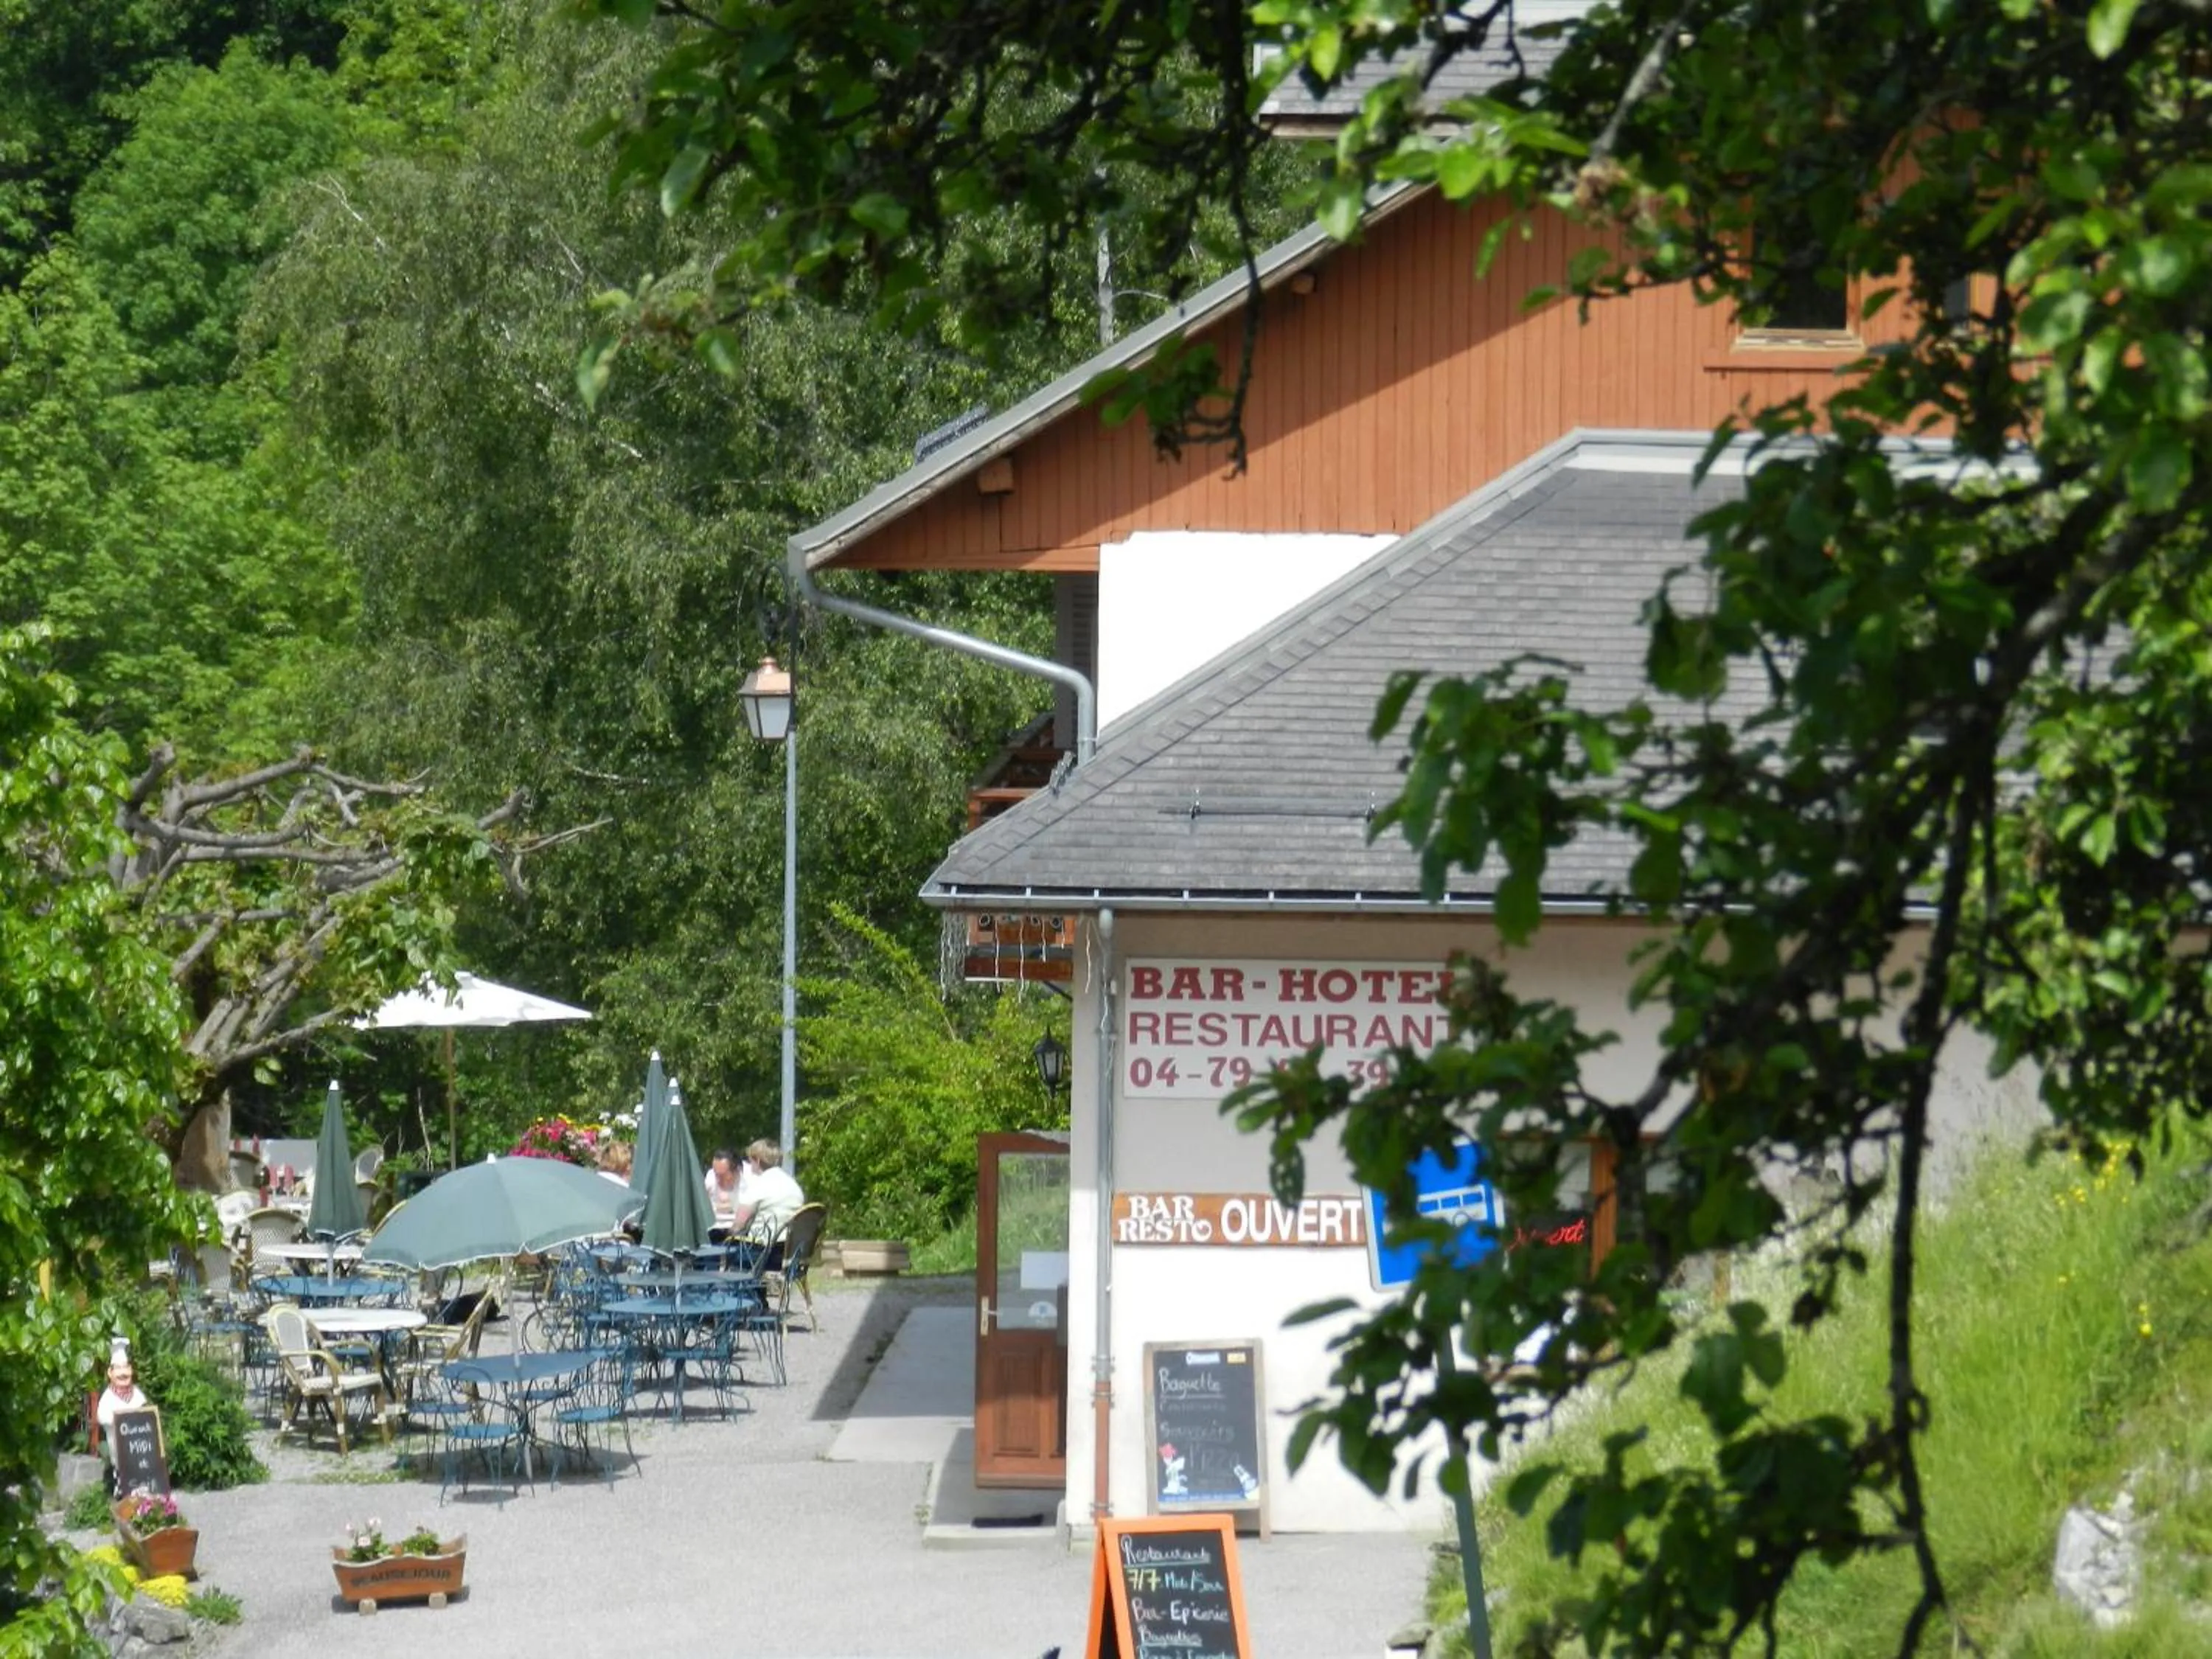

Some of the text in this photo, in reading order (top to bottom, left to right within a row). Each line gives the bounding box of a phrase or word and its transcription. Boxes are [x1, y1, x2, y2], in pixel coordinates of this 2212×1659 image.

[1128, 1195, 1195, 1219] BAR
[1119, 1218, 1214, 1242] RESTO
[1220, 1198, 1363, 1242] OUVERT
